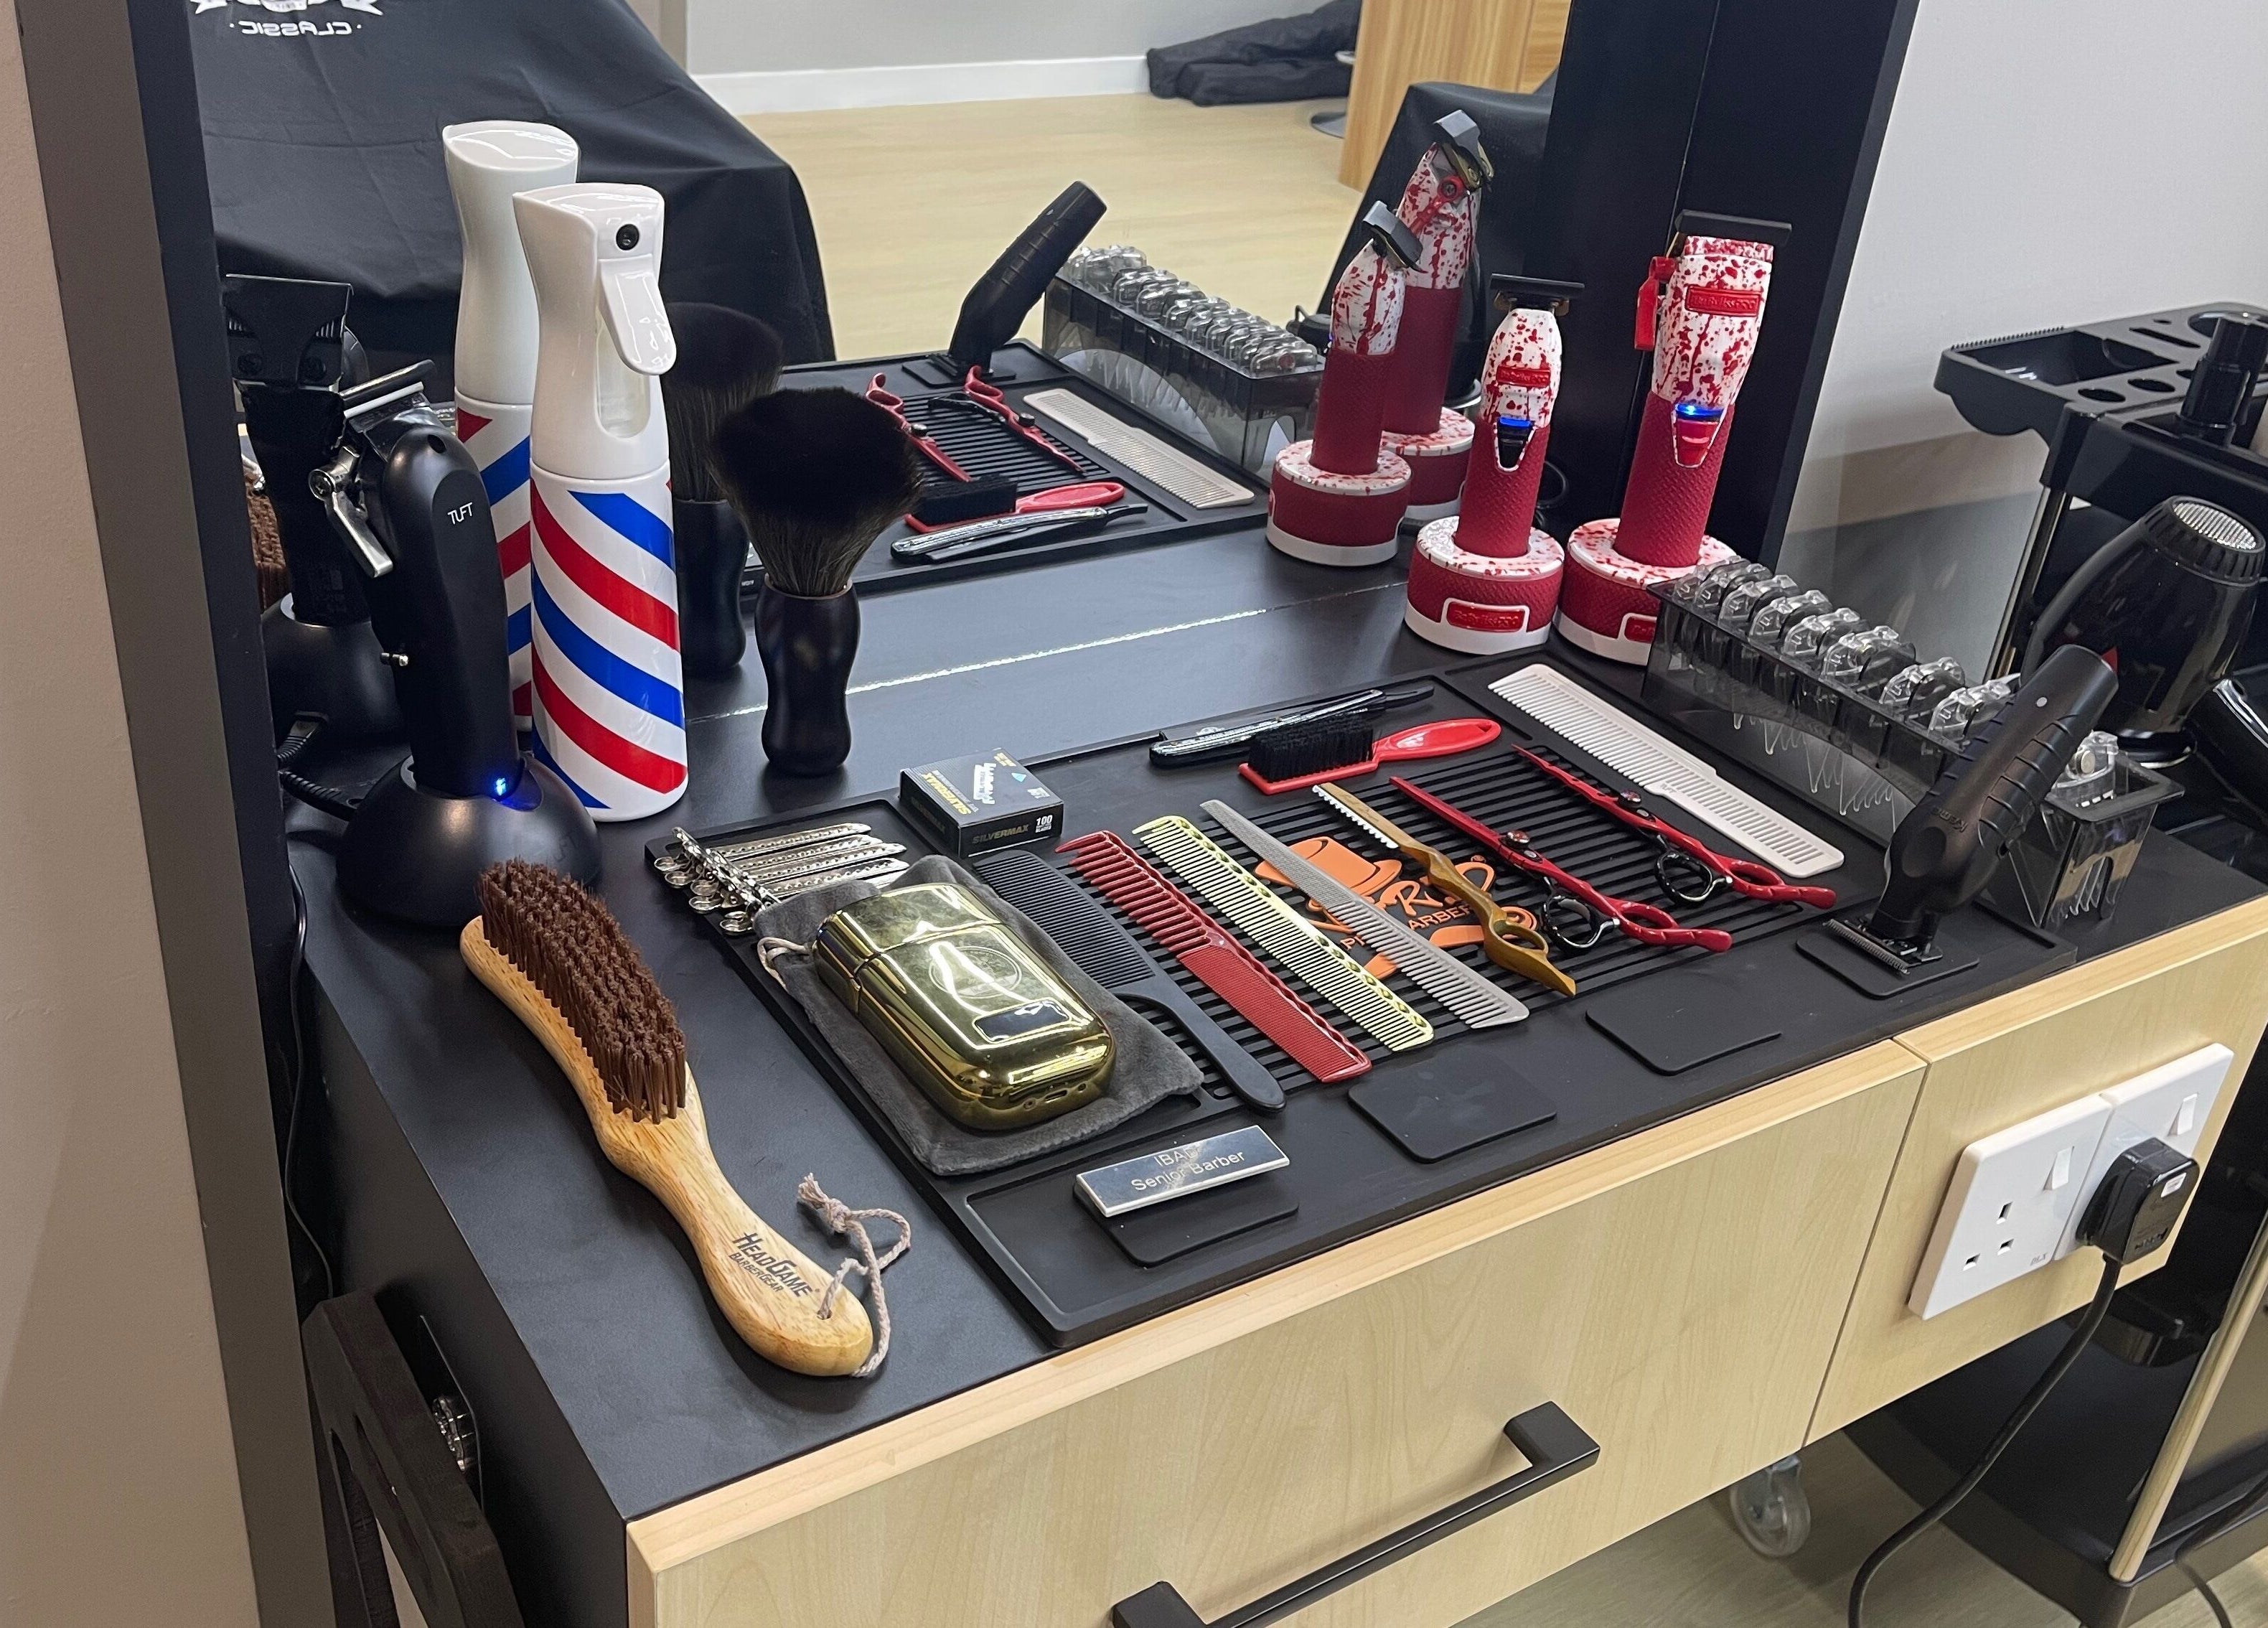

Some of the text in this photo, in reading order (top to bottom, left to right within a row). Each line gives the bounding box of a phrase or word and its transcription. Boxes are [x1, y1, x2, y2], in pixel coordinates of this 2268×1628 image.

[447, 502, 473, 525] TUFT
[1036, 814, 1053, 826] 100
[972, 823, 1029, 844] SILVERMAX
[1130, 1151, 1246, 1192] Senior Barber
